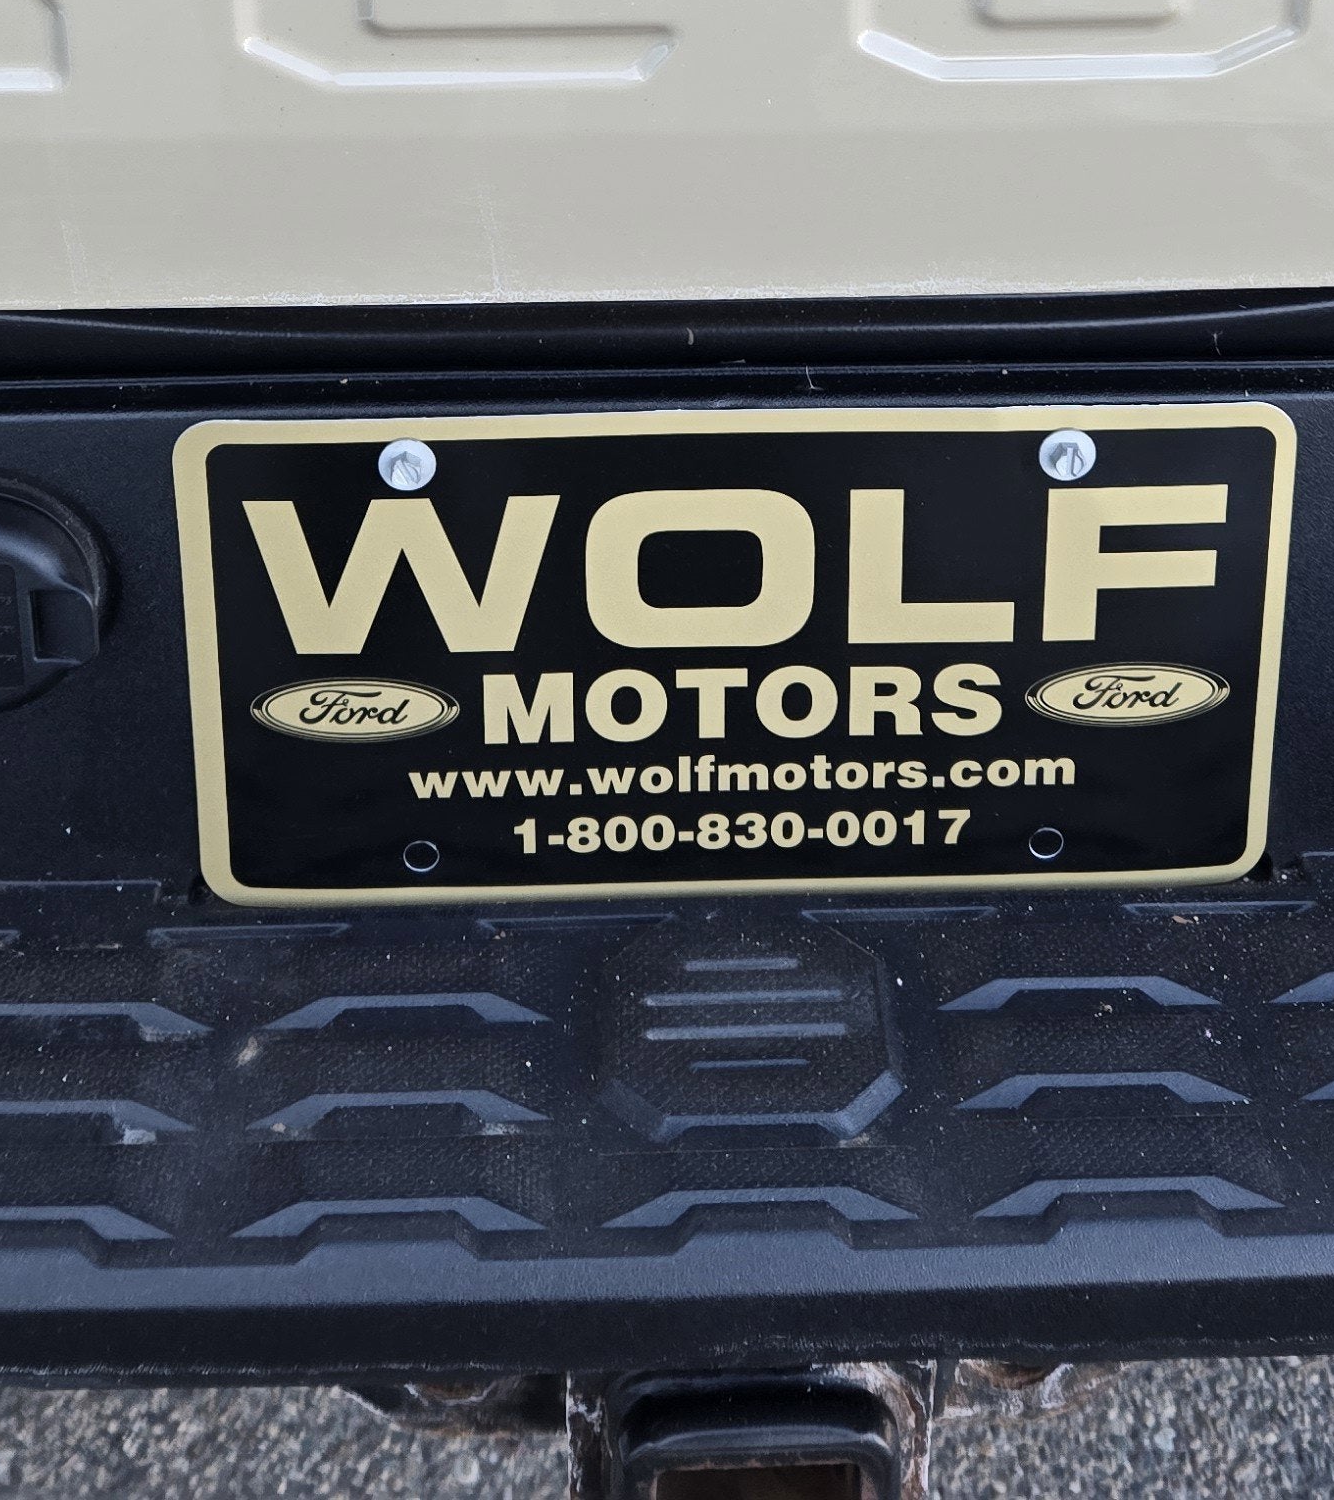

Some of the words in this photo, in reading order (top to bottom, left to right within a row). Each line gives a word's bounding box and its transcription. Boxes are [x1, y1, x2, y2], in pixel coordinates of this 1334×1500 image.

[241, 483, 1228, 655] WOLF
[298, 688, 409, 729] Ford
[481, 662, 1003, 745] MOTORS
[1071, 673, 1181, 711] Ford
[409, 753, 1076, 799] www.wolfmotors.com
[513, 809, 971, 854] 1-800-830-0017
